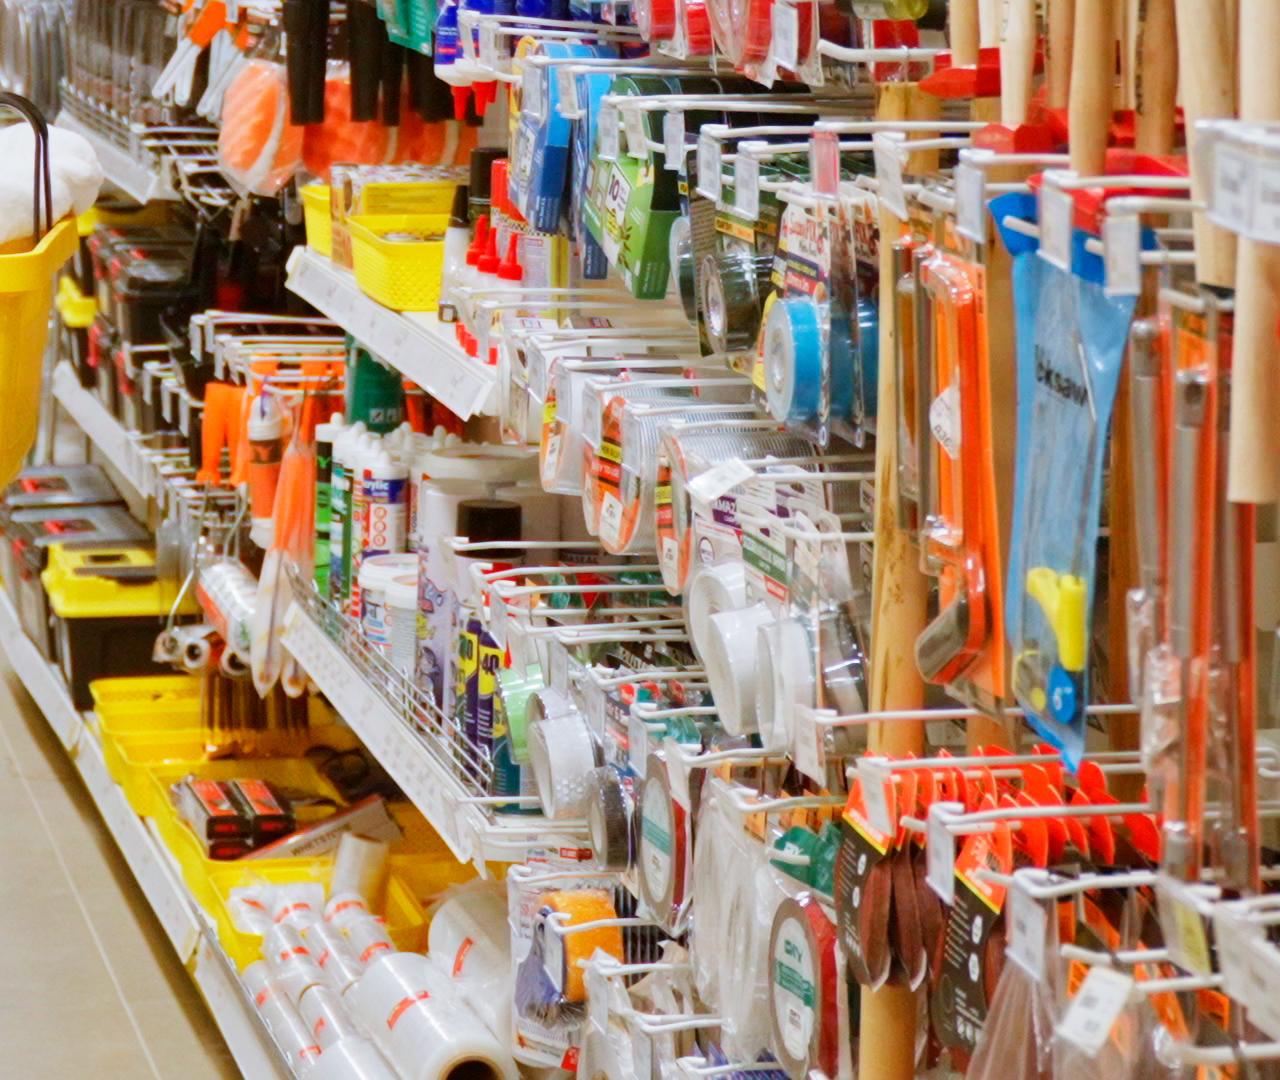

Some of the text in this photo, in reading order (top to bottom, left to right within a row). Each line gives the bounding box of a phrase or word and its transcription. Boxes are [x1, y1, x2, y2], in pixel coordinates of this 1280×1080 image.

[609, 173, 620, 201] 10
[482, 653, 500, 676] 40
[783, 939, 804, 963] DIY
